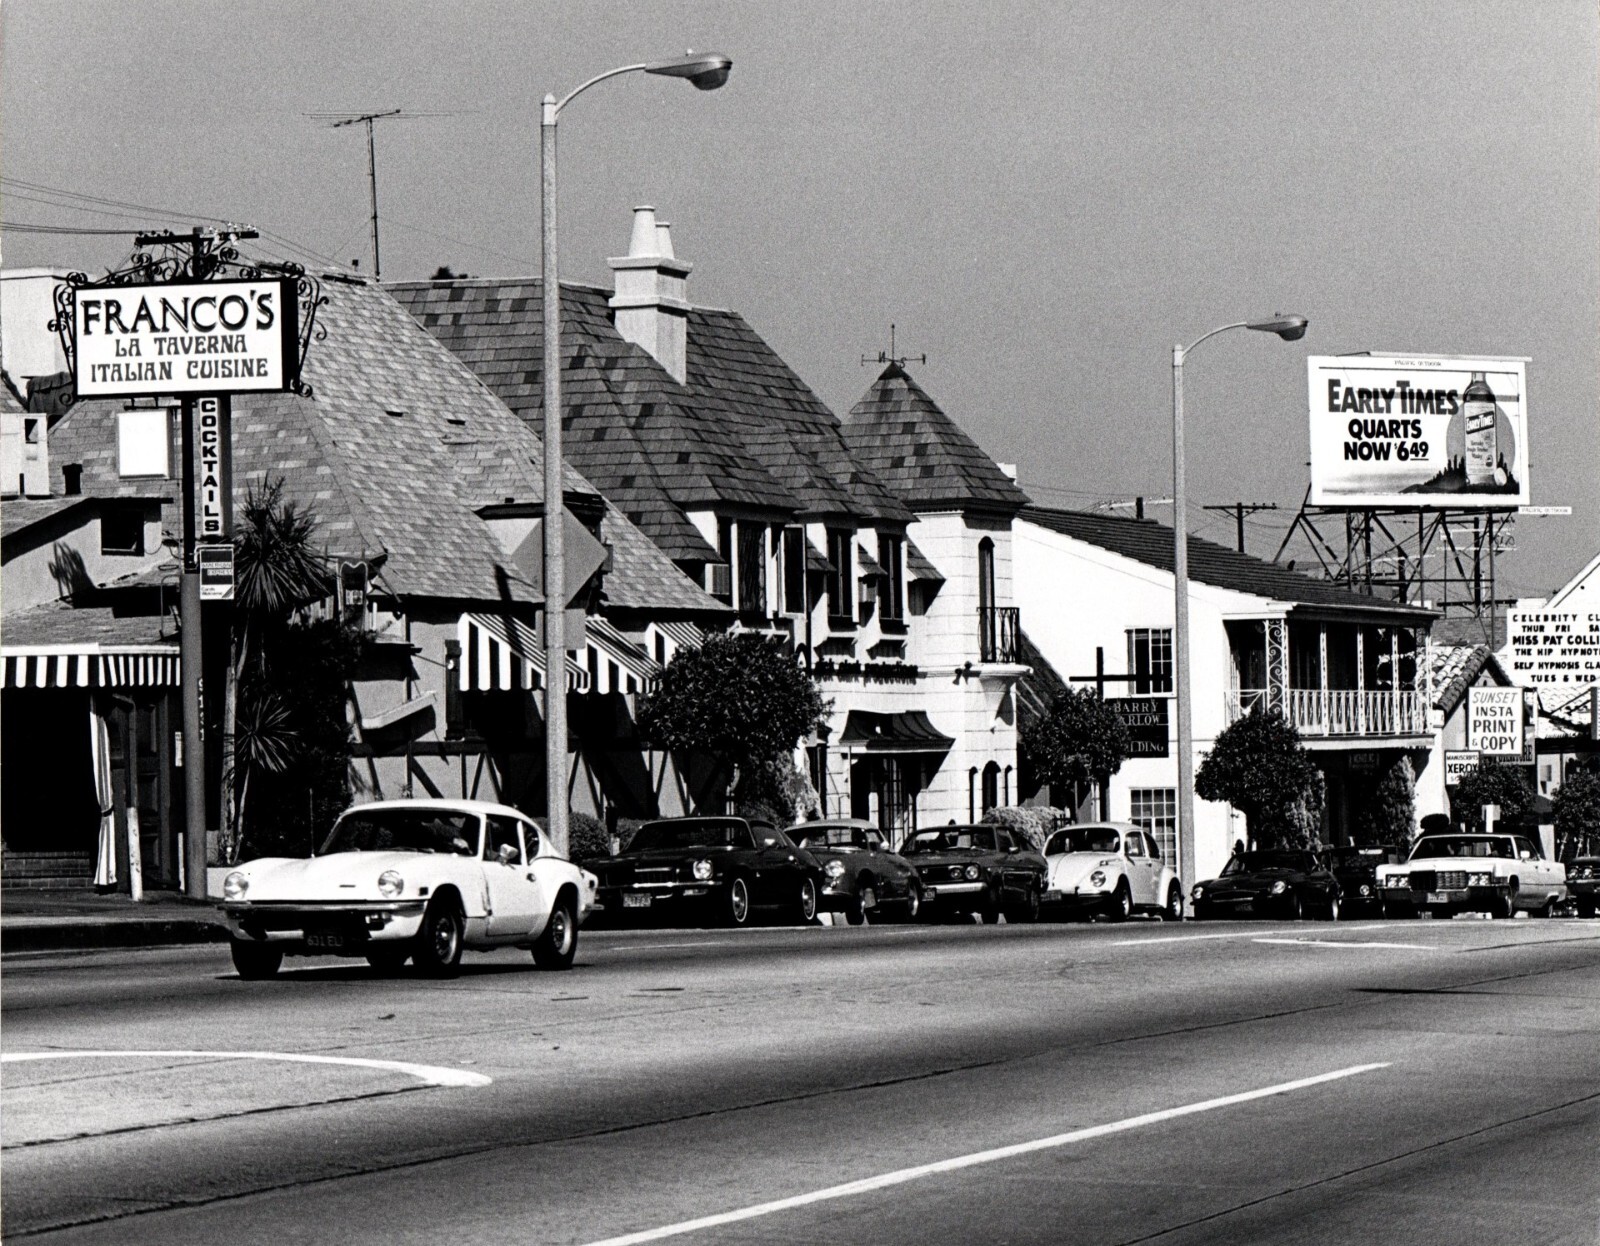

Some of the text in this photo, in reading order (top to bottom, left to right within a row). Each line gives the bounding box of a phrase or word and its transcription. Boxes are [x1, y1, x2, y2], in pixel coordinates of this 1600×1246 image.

[81, 289, 275, 336] FRANCO'S
[115, 334, 248, 357] LA TAVERNA
[91, 358, 269, 383] ITALIAN CUISINE
[1348, 419, 1422, 440] QUARTS
[1344, 441, 1391, 461] NOW
[201, 401, 219, 531] COCKTAILS
[1512, 613, 1578, 623] CELEBRITY
[1521, 624, 1600, 633] THUR FRI SA
[1512, 635, 1539, 646] MISS
[1543, 635, 1563, 646] PAT
[1515, 648, 1532, 656] THE
[1537, 648, 1553, 656] HIP
[1514, 661, 1534, 670] SELF
[1538, 661, 1580, 670] HYPNOSIS
[1531, 674, 1556, 683] TUES
[1575, 674, 1597, 683] WED
[1472, 691, 1519, 704] SUNSET
[1114, 702, 1158, 713] BARRY
[1475, 706, 1514, 717] INSTA
[1120, 714, 1160, 725] ARLOW
[1473, 719, 1516, 733] PRINT
[1472, 736, 1517, 751] & COPY
[1448, 763, 1479, 774] XEROX
